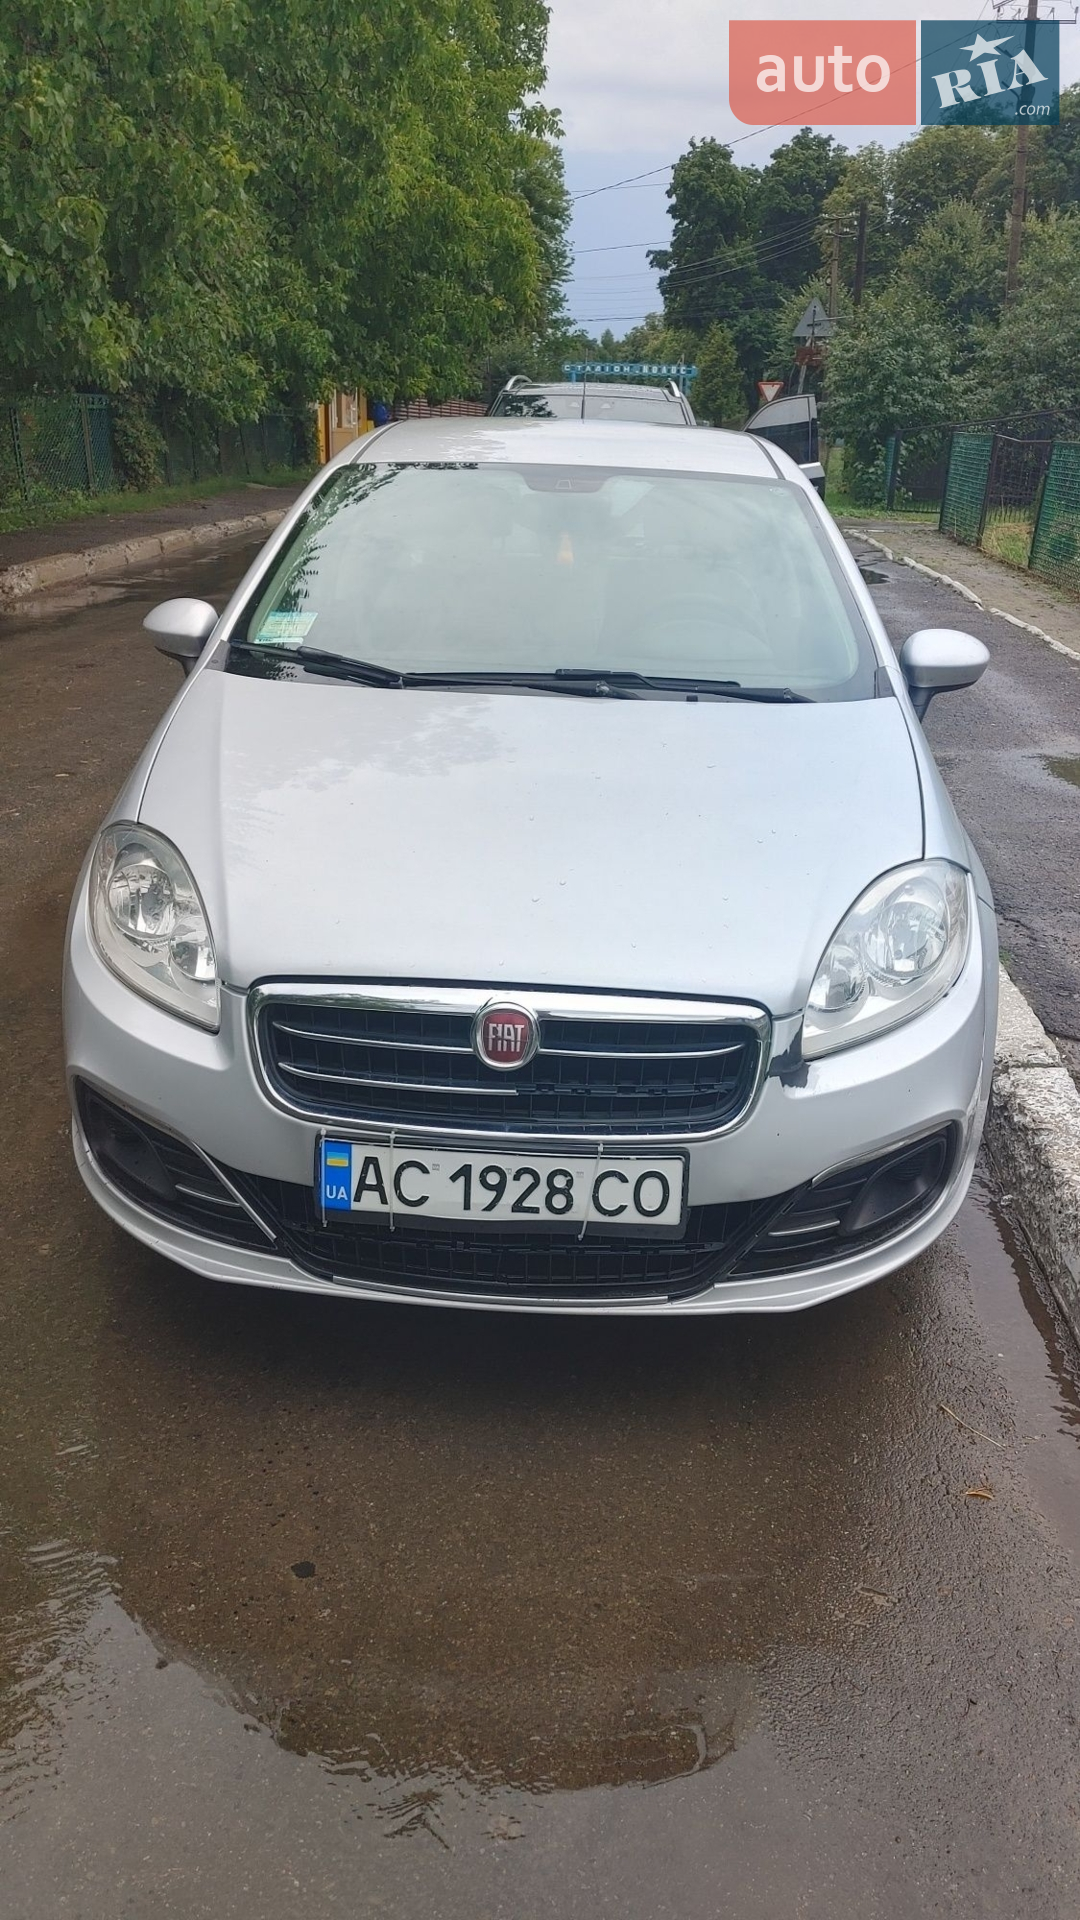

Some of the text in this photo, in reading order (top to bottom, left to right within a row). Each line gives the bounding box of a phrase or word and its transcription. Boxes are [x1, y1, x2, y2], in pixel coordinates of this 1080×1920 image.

[488, 1023, 525, 1053] FIAT
[325, 1184, 348, 1201] UA
[353, 1155, 670, 1218] AC 1928 CO
